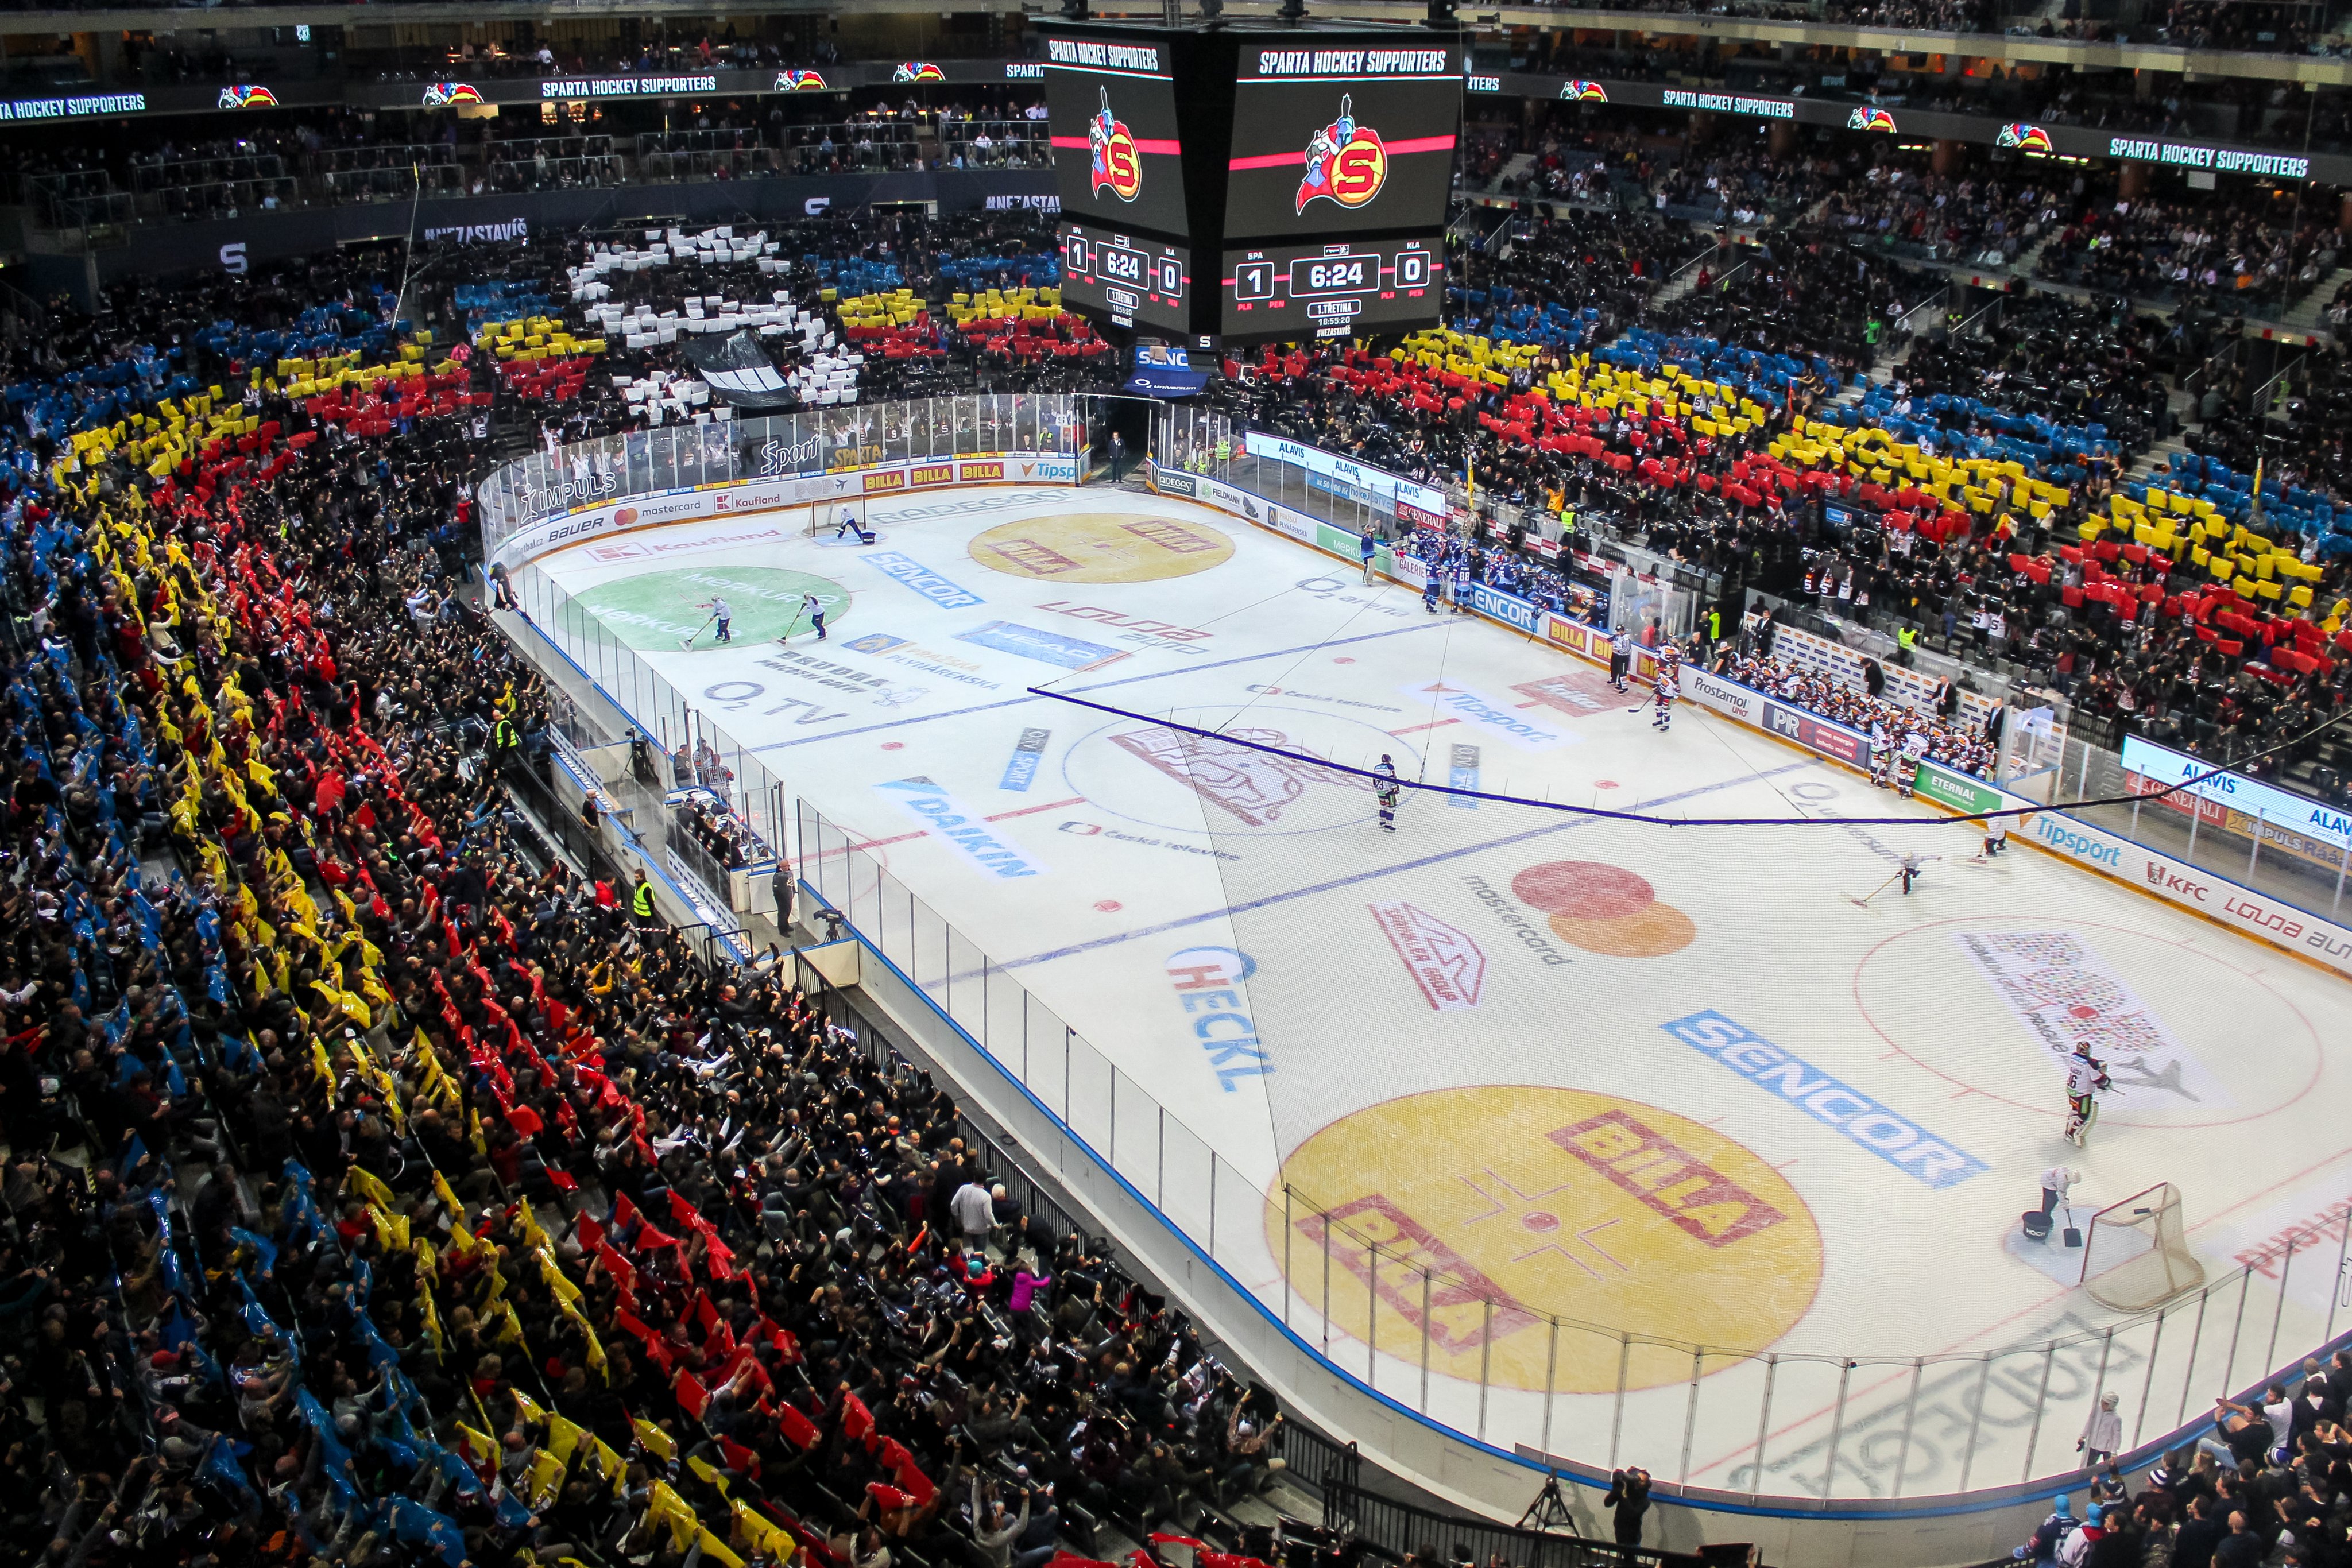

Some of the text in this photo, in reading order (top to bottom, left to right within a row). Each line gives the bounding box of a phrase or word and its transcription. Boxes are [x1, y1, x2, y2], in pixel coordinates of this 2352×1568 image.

[1049, 40, 1159, 71] SPARTA HOCKEY SUPPORTERS
[1259, 50, 1446, 74] SPARTA HOCKEY SUPPORTERS
[542, 76, 716, 97] SPARTA HOCKEY SUPPORTERS
[16, 99, 65, 119] HOCKEY
[67, 94, 145, 114] SUPPORTERS
[1664, 90, 1794, 118] SPARTA HOCKEY SUPPORTERS
[2110, 138, 2309, 178] SPARTA HOCKEY SUPPORTERS
[219, 242, 248, 274] S
[1073, 242, 1081, 266] 1
[1165, 247, 1175, 257] KLA
[1247, 251, 1263, 260] SPA
[1406, 241, 1421, 250] KLA
[1107, 251, 1139, 280] 6:24
[1165, 265, 1176, 290] 0
[1310, 262, 1363, 288] 6:24
[1404, 257, 1421, 282] 0
[1247, 268, 1262, 293] 1
[1408, 289, 1425, 297] PEN
[1268, 300, 1286, 309] PEN
[1318, 316, 1351, 326] 18:55:20
[760, 433, 821, 475] Sport
[834, 444, 883, 467] SPARTA
[1279, 442, 1305, 459] ALAVIS
[913, 468, 951, 483] BILLA
[962, 464, 1002, 479] BILLA
[1334, 460, 1359, 477] ALAVIS
[539, 471, 617, 511] IMPULS
[865, 473, 903, 490] BILLA
[1323, 481, 1330, 489] 50
[642, 500, 701, 517] mastercard
[736, 493, 780, 508] Kaufland
[1212, 487, 1240, 505] FIELDMANN
[1409, 507, 1442, 530] GENERALI
[866, 553, 977, 606] SENCOR
[1399, 558, 1425, 579] GALERIE
[1459, 571, 1471, 582] 88
[985, 629, 1099, 660] HEAD
[1551, 621, 1585, 649] BILLA
[1694, 676, 1749, 710] Prostamol
[763, 696, 850, 725] TV
[1442, 693, 1558, 744] Tipsport
[1732, 706, 1748, 718] UNO
[1773, 708, 1814, 744] PRE
[1931, 776, 1976, 802] ETERNAL
[906, 797, 1039, 878] DAIKIN
[2038, 815, 2122, 868] Tipsport
[2165, 874, 2210, 902] KFC
[1462, 874, 1576, 967] mastercard
[1166, 964, 1277, 1093] HECKL
[1674, 1017, 1967, 1181] SENCOR
[1568, 1122, 1757, 1239] BILLA
[1325, 1206, 1500, 1342] BILLA
